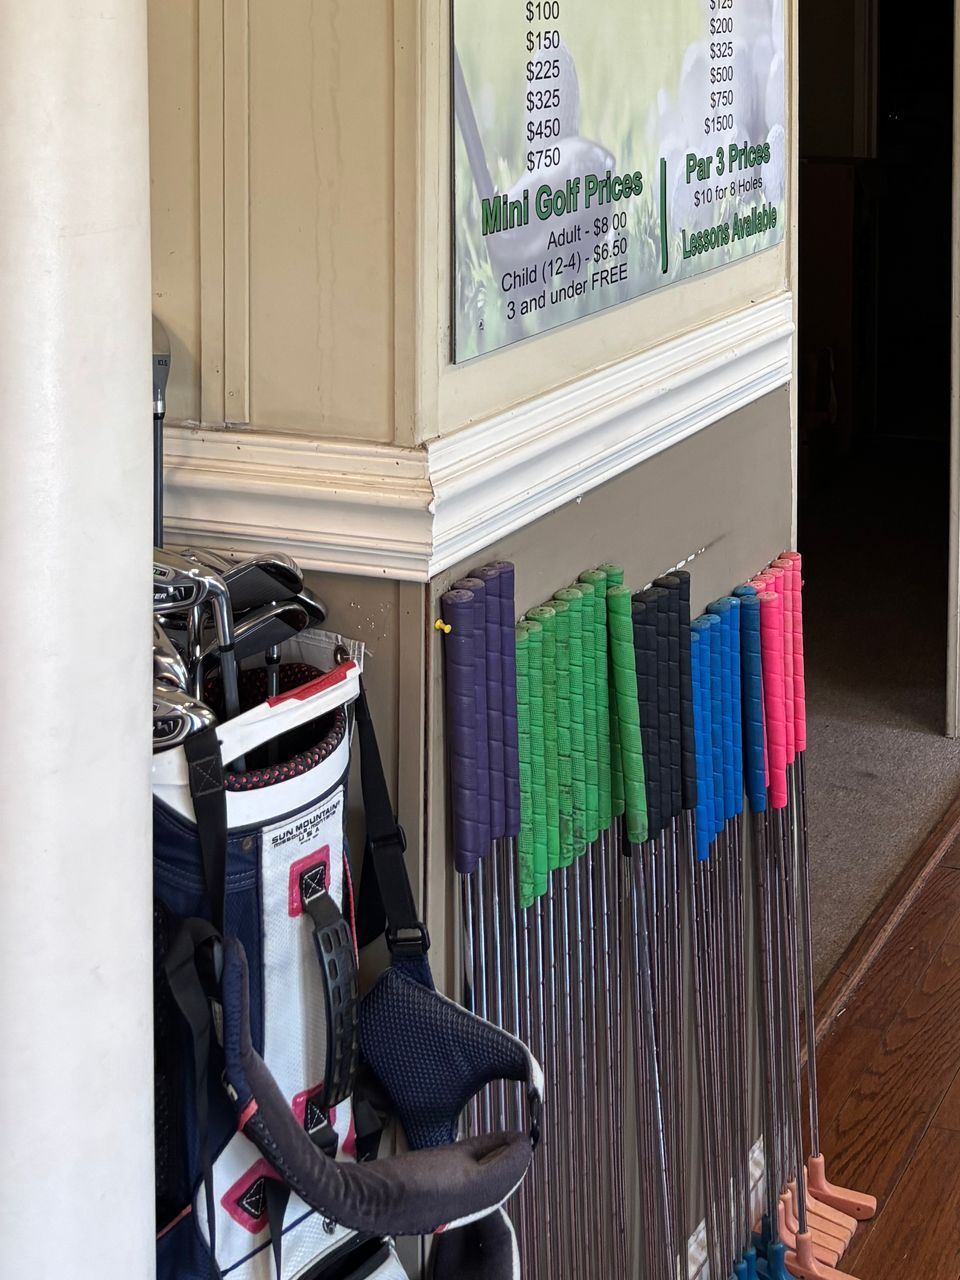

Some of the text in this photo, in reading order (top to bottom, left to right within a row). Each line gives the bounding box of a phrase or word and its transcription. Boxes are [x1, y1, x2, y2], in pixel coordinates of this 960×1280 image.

[525, 0, 560, 23] $100
[709, 17, 733, 35] $200
[526, 30, 560, 53] $150
[709, 41, 734, 60] $325
[526, 59, 560, 83] $225
[710, 66, 734, 84] $500
[526, 88, 561, 112] $325
[710, 89, 734, 109] $750
[527, 117, 561, 142] $450
[704, 113, 734, 136] $1500
[527, 147, 561, 172] $750
[685, 141, 771, 184] Par 3 Prices
[481, 169, 644, 237] Mini Golf Prices
[693, 176, 763, 209] $10 for 8 Holes
[547, 224, 582, 250] Adult
[682, 201, 777, 260] Lessons Available
[501, 263, 538, 293] Child
[541, 251, 581, 286] (12-4)
[593, 237, 628, 264] $6.50
[506, 262, 628, 320] 3 and under FREE
[271, 828, 294, 845] SUN
